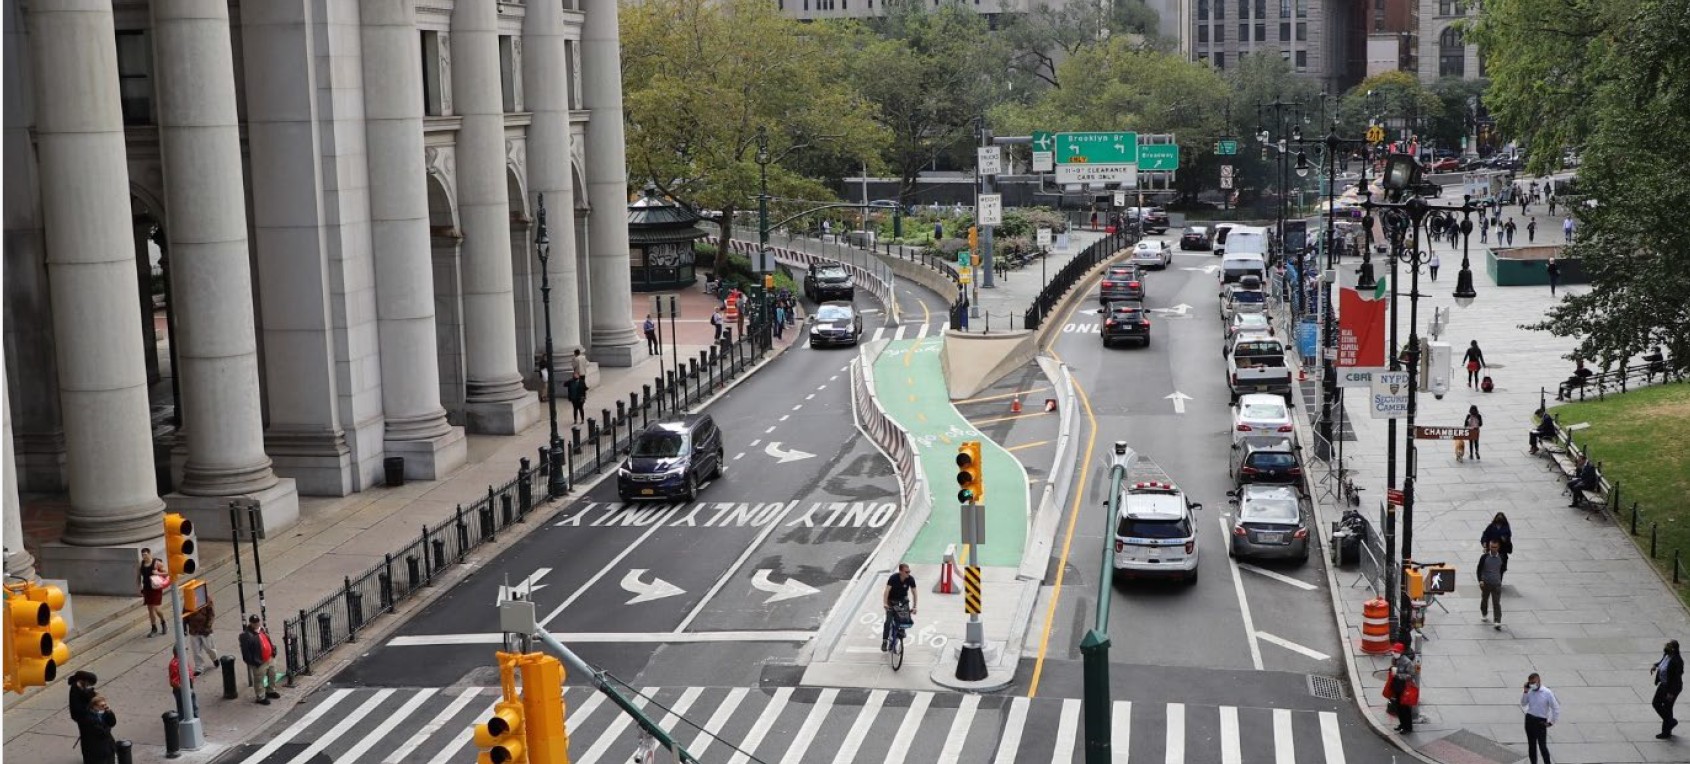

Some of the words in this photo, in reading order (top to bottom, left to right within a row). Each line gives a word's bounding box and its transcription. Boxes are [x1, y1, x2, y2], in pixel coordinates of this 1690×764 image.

[1113, 134, 1124, 142] Br
[1062, 323, 1102, 334] ONL
[1423, 427, 1470, 437] CHAMBERS
[785, 502, 897, 527] ONLY
